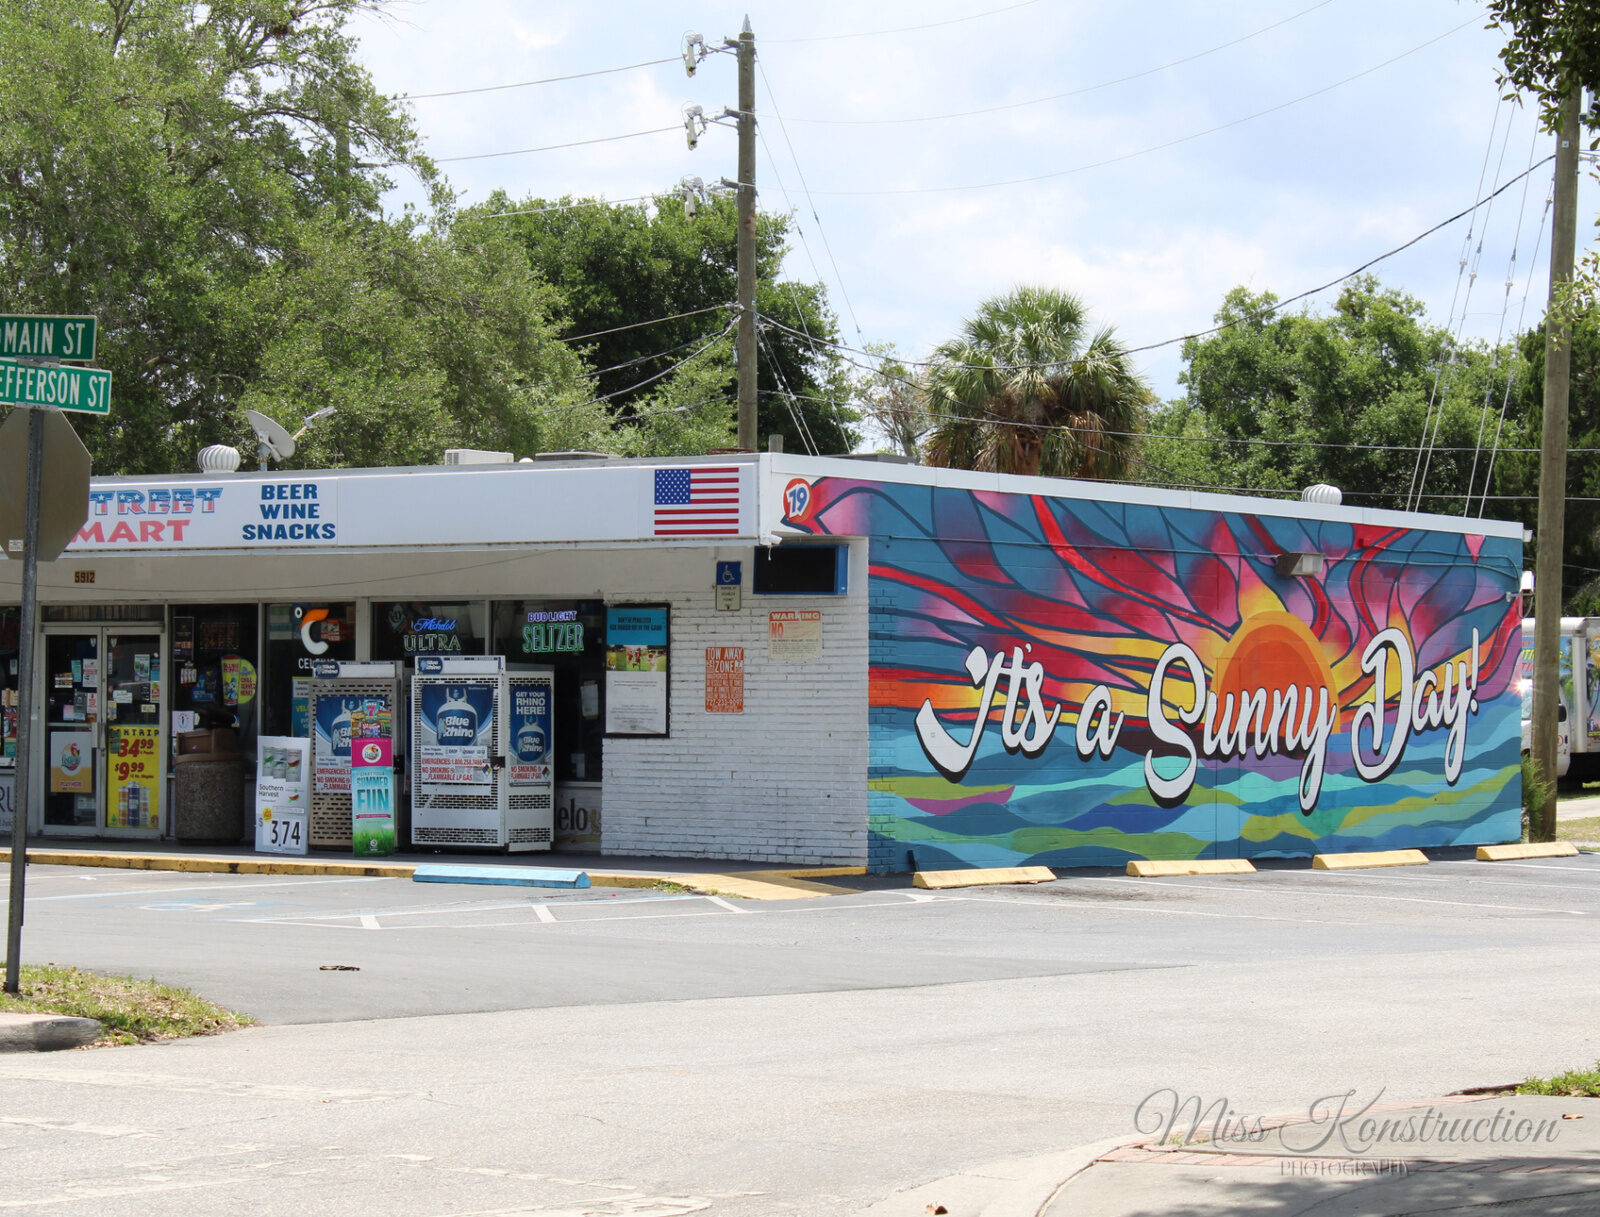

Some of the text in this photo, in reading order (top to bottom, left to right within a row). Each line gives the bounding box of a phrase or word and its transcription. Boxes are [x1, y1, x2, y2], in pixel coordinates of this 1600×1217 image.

[4, 322, 86, 355] MAIN ST
[87, 378, 107, 408] ST
[261, 484, 318, 501] BEER
[787, 484, 810, 517] 19
[260, 504, 320, 520] WINE
[72, 519, 190, 543] MART
[242, 523, 336, 540] SNACKS
[74, 571, 95, 583] 5912
[527, 611, 578, 623] BUD LIGHT
[522, 622, 586, 653] SELTZER
[771, 622, 784, 639] NO
[404, 633, 461, 652] ULTRA
[707, 648, 743, 660] TOW AWAY
[714, 660, 735, 673] ZONE
[516, 691, 546, 700] GET YOUR
[516, 699, 546, 707] RHINO
[516, 707, 546, 715] HERE!
[445, 716, 469, 726] Blue
[915, 626, 1480, 816] It's a Sunny Day!
[443, 726, 474, 738] Rhino
[523, 734, 540, 744] Blue
[325, 776, 346, 784] SMOKING
[357, 776, 389, 787] SUMMER
[259, 783, 284, 794] Southern
[357, 788, 390, 812] FUN
[271, 819, 301, 847] 3.74
